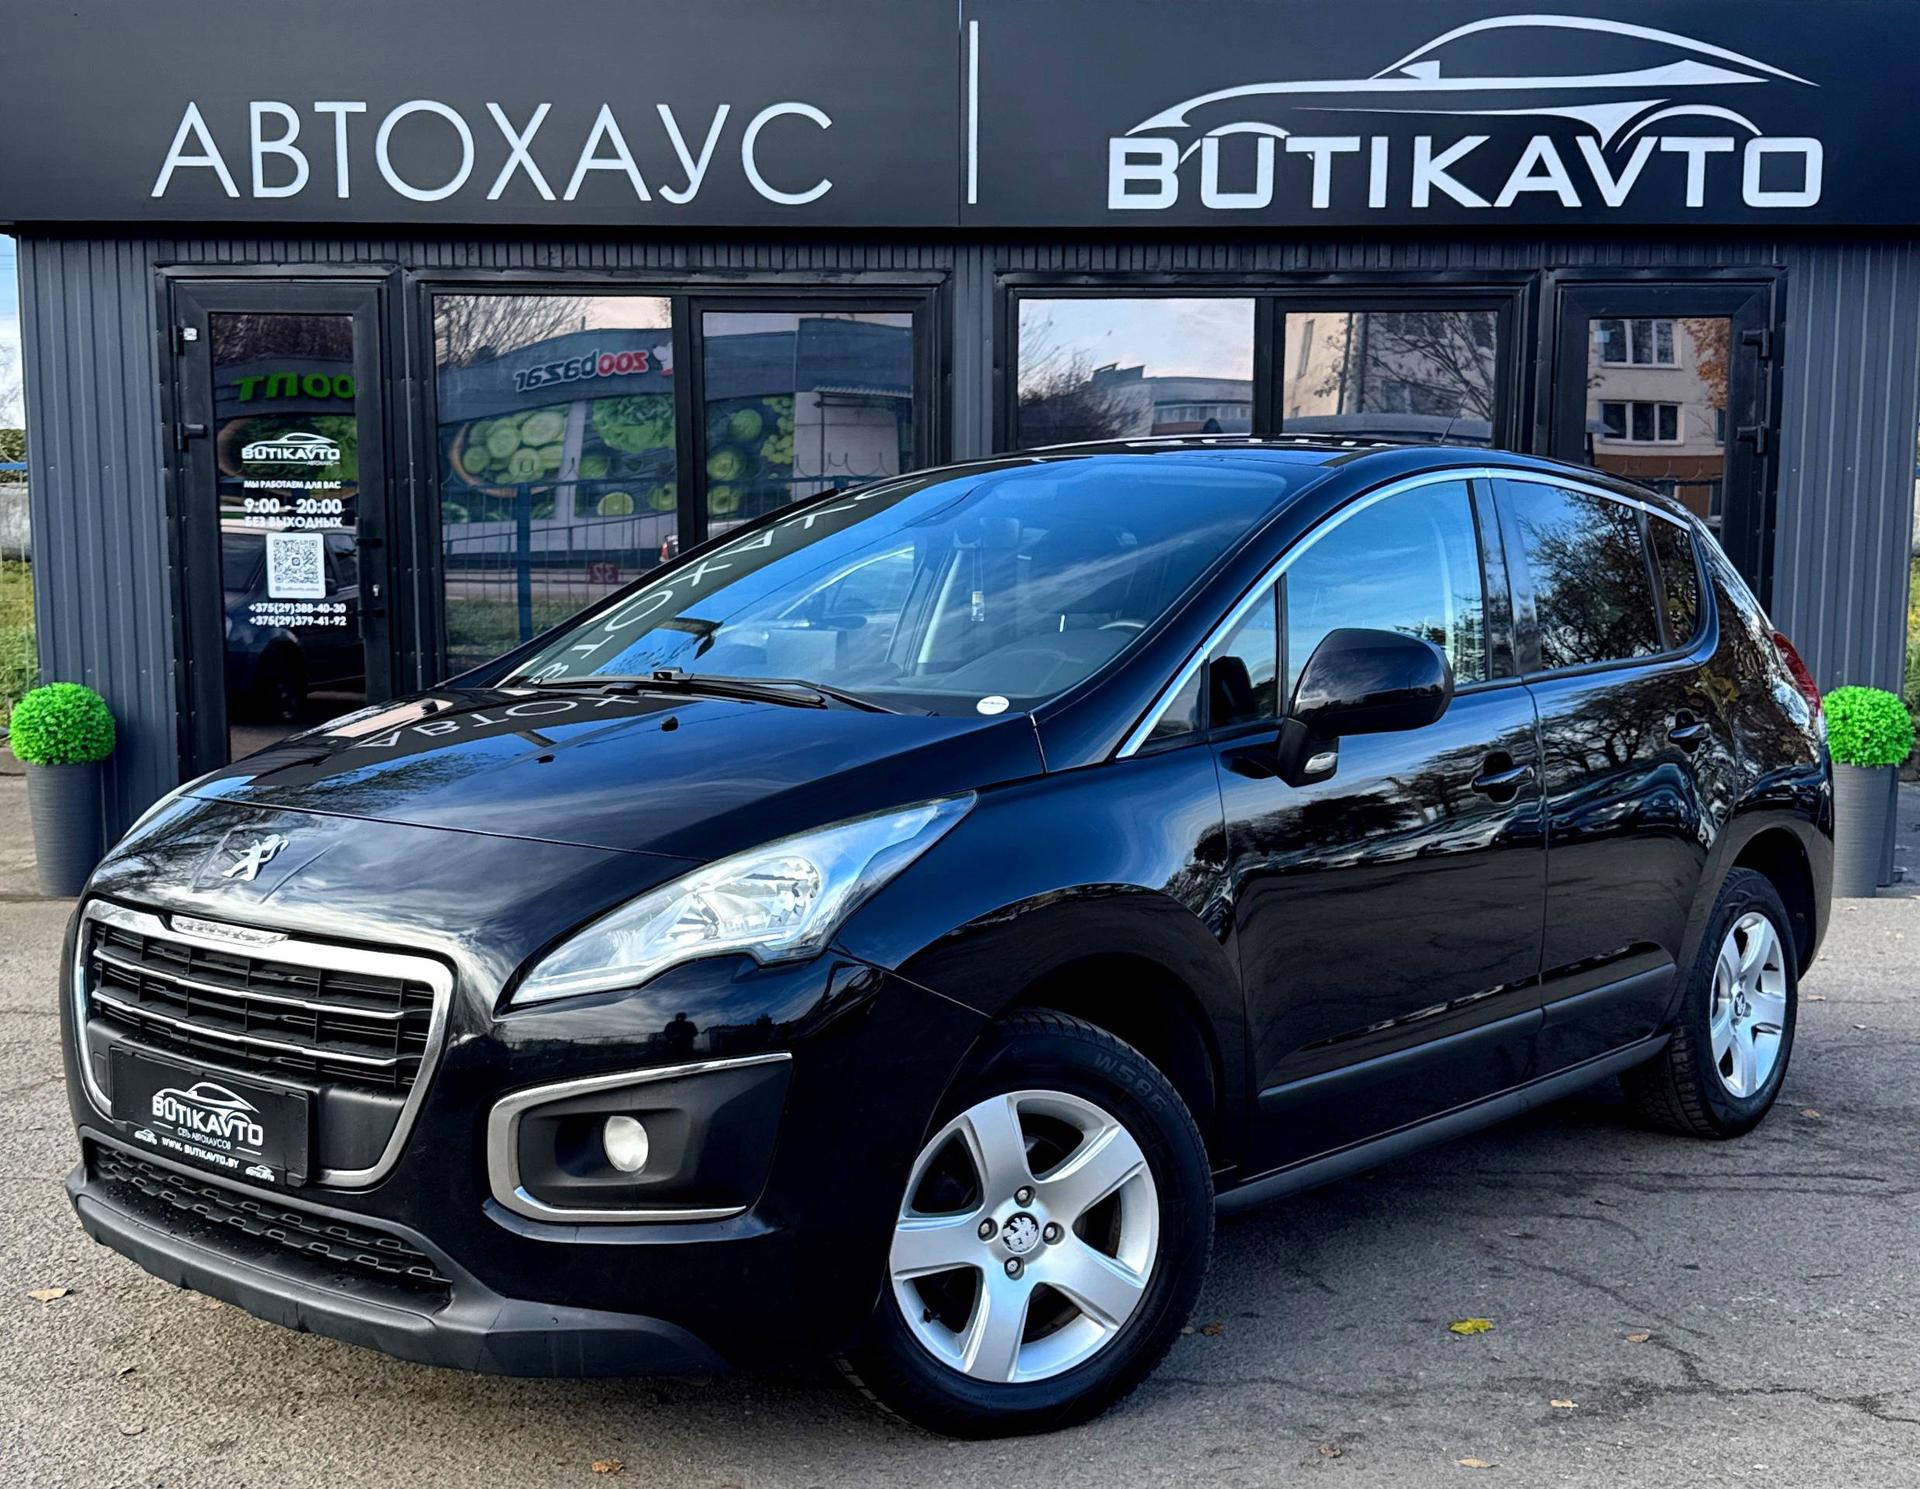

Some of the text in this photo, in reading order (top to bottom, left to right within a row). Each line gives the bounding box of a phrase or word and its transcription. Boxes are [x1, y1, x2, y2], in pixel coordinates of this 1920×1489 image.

[151, 99, 834, 205] АВТОХАУС
[1107, 134, 1825, 211] BUTIKAVTO
[241, 446, 341, 461] BUTIKAVTO
[243, 480, 341, 490] МЫ РАБОТАЕМ ДЛЯ ВАС
[243, 498, 280, 514] 9:00
[296, 498, 343, 514] 20:00
[244, 516, 343, 529] БЕЗ ВЫХОДНЫХ
[248, 602, 347, 614] +375(29)388-40-30
[249, 615, 348, 628] +375(29)379-41-92
[152, 1094, 264, 1147] BUTIKAVTO
[184, 1144, 240, 1169] BUTIKAVTO.BY
